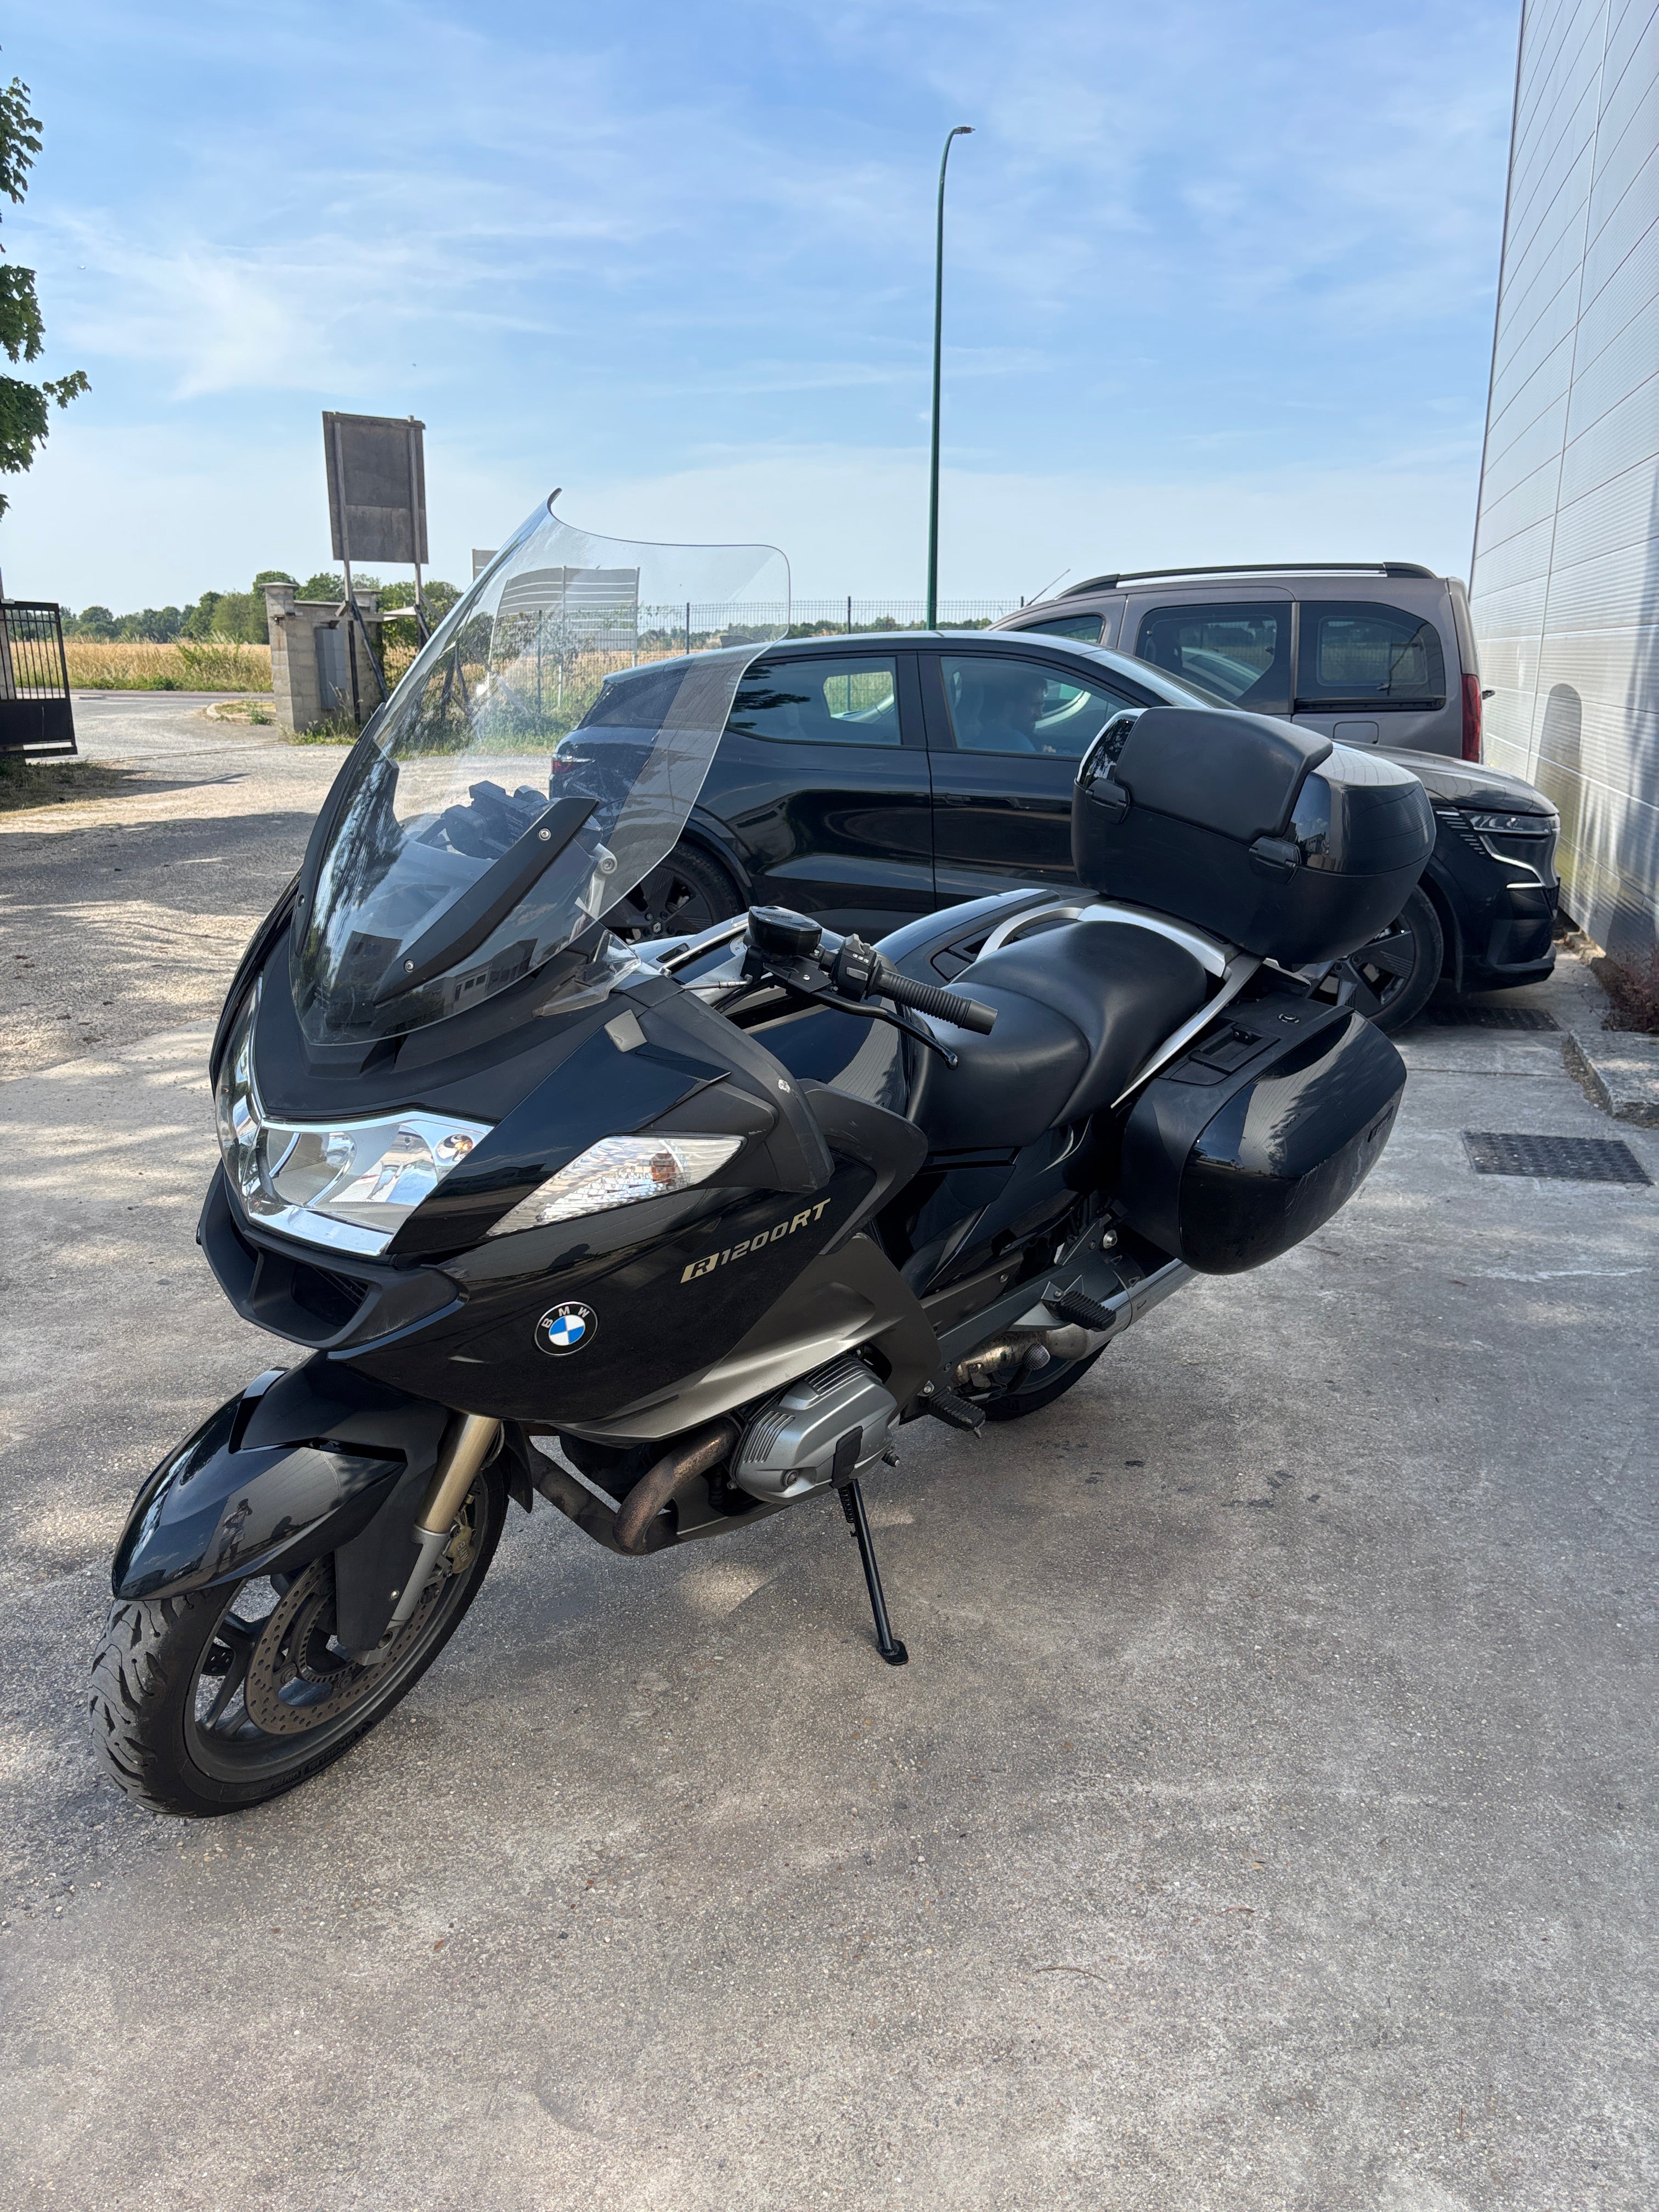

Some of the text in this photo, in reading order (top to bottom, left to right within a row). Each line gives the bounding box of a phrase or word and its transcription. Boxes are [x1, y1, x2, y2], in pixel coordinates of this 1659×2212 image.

[681, 1198, 831, 1283] R1200RT
[541, 1306, 590, 1328] BMW
[457, 1541, 469, 1562] BMW
